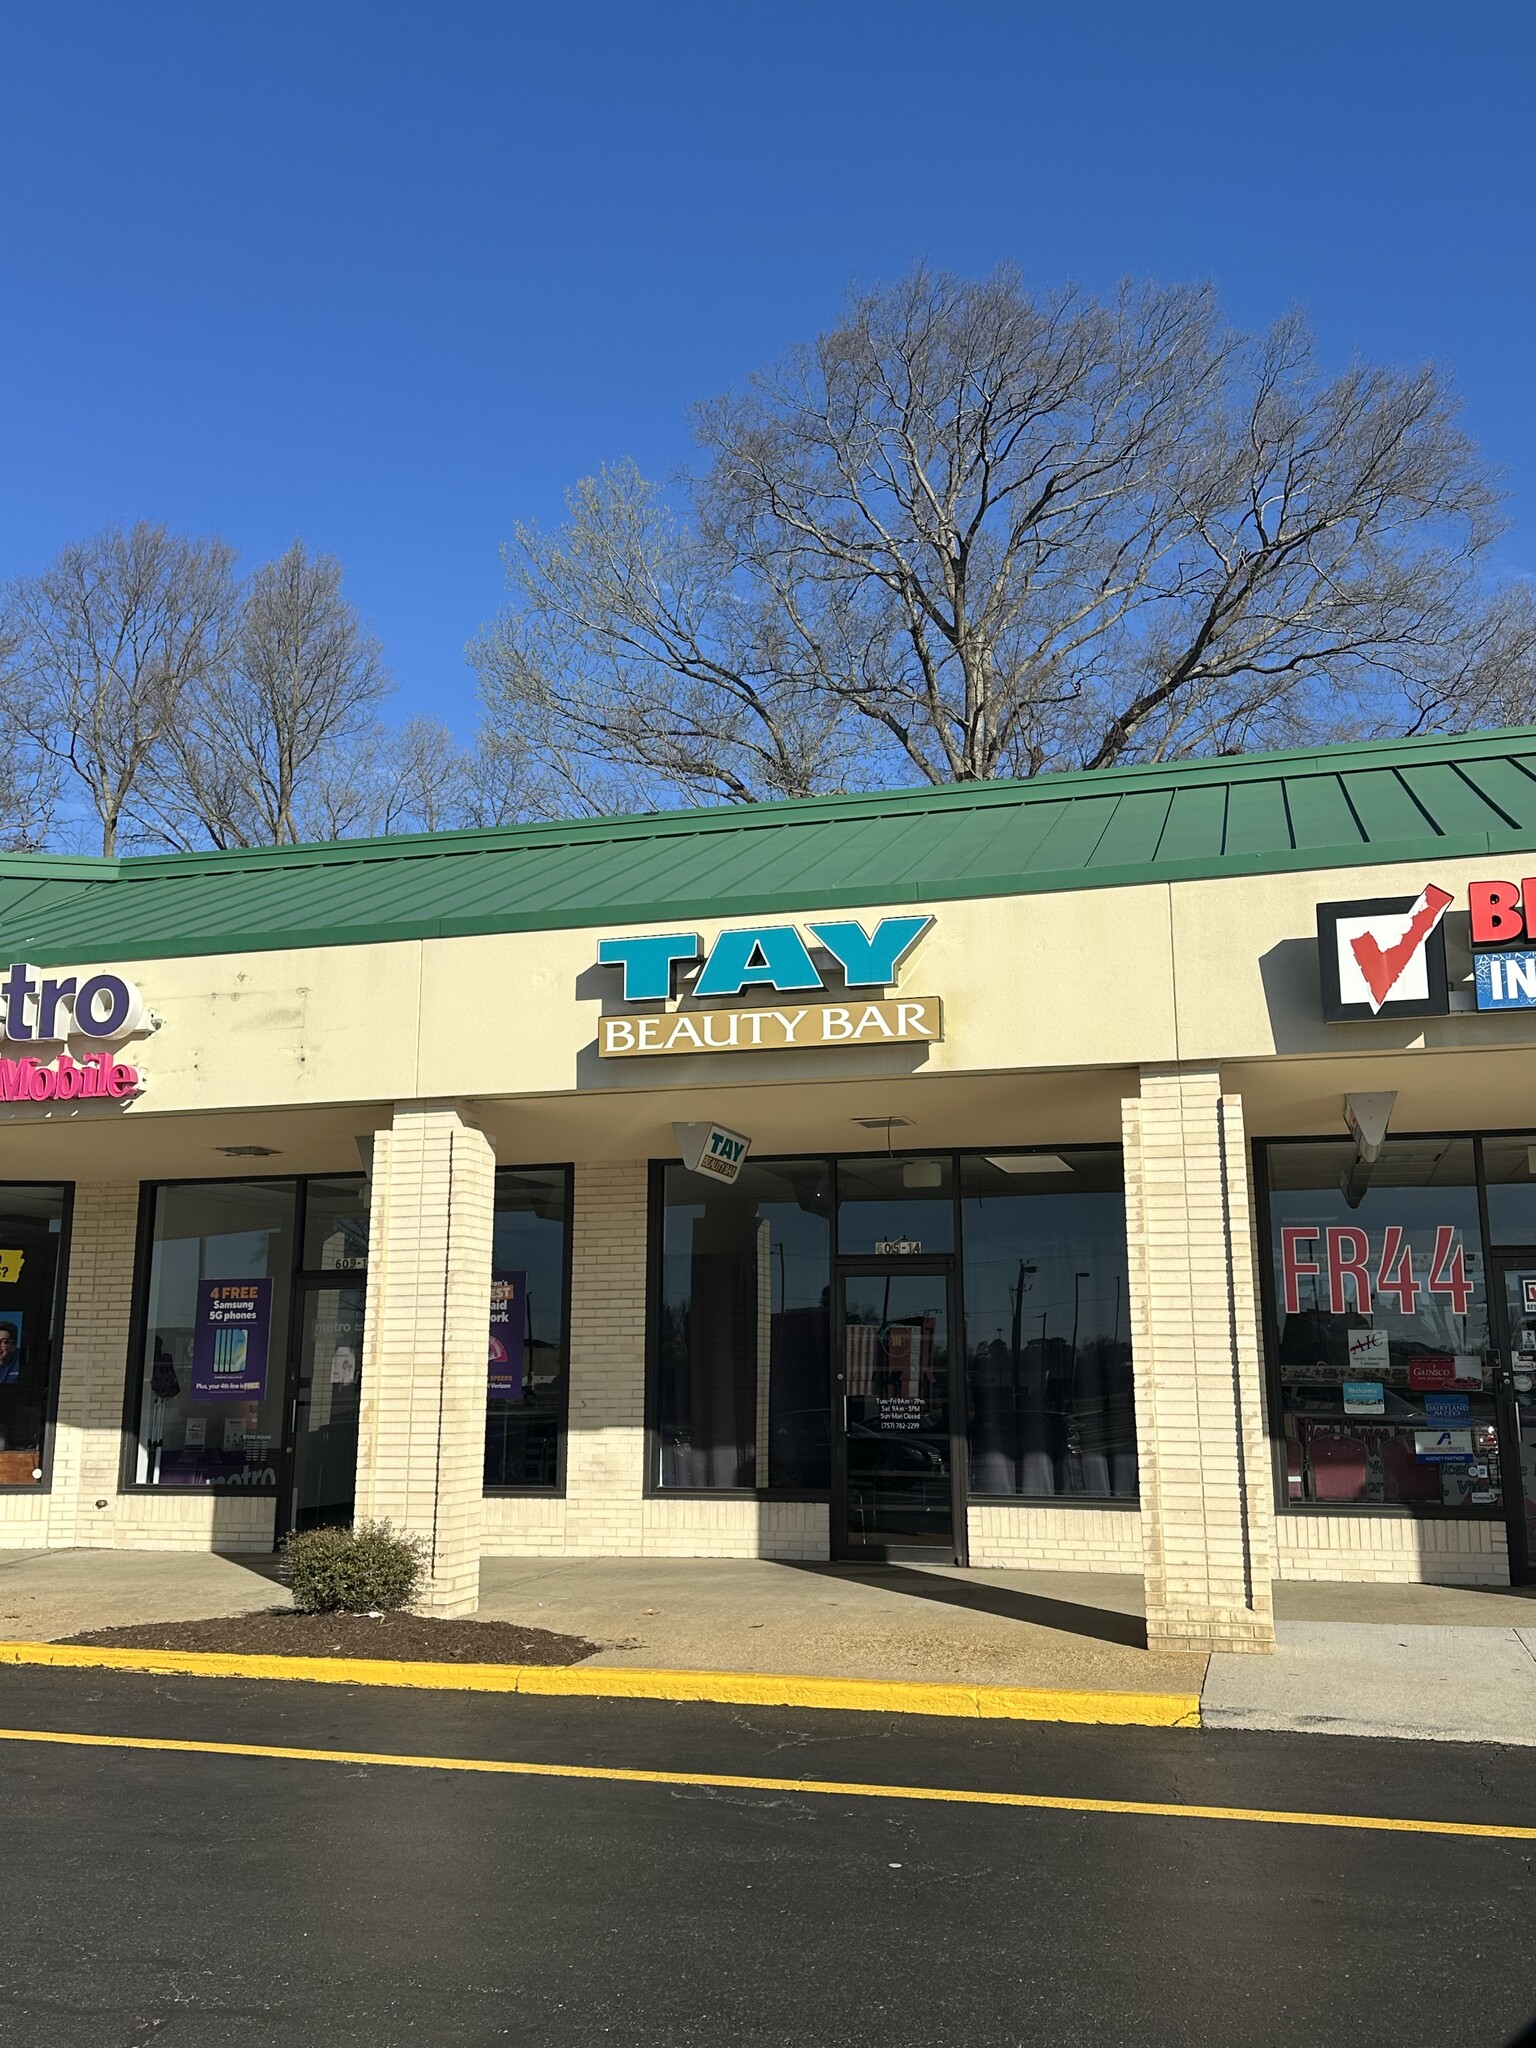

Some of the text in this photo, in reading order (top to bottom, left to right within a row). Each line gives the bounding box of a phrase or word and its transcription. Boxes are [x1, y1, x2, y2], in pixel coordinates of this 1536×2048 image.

[1468, 878, 1536, 947] B
[597, 915, 936, 1001] TAY
[1490, 958, 1536, 1001] IN
[1, 963, 137, 1042] tro
[604, 1003, 934, 1053] BEAUTY BAR
[0, 1053, 138, 1102] Mobile
[711, 1132, 745, 1162] TAY
[702, 1156, 737, 1178] BEAUTY BAR
[1281, 1225, 1474, 1315] FR44
[210, 1286, 258, 1299] 4 FREE
[209, 1311, 257, 1322] 5G phones
[213, 1300, 254, 1310] Samsung
[490, 1300, 508, 1310] aid
[490, 1312, 510, 1322] ork
[315, 1322, 351, 1333] metro
[1351, 1331, 1383, 1355] AIC
[208, 1383, 220, 1391] your
